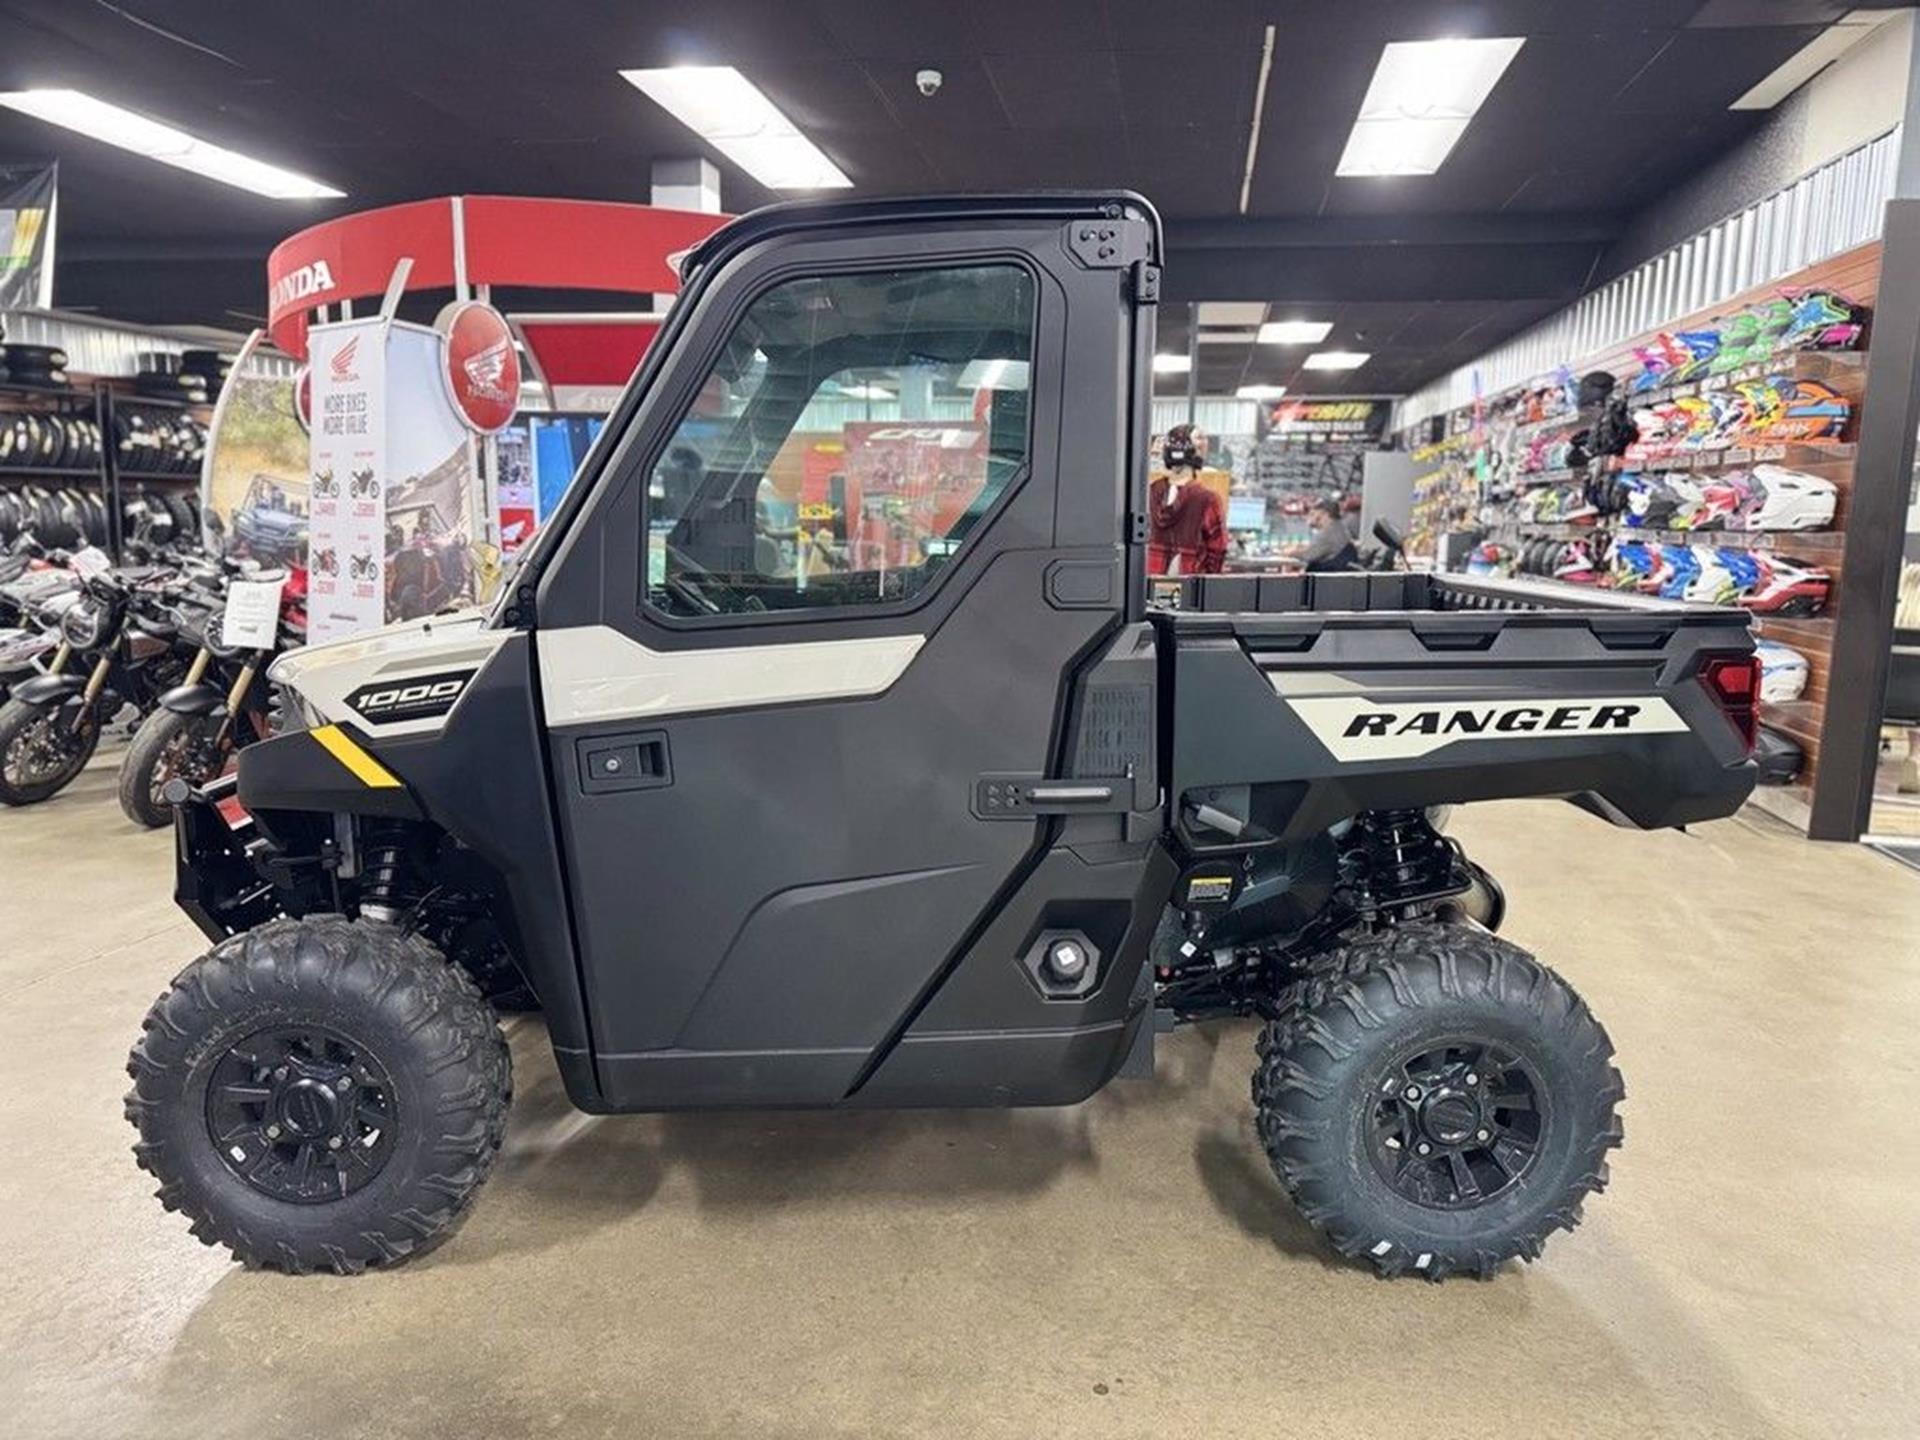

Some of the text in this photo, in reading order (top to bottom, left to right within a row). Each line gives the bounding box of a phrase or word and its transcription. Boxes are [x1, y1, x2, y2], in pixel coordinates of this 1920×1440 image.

[269, 259, 336, 305] ONDA
[357, 680, 464, 710] 1000
[1343, 704, 1641, 738] RANGER
